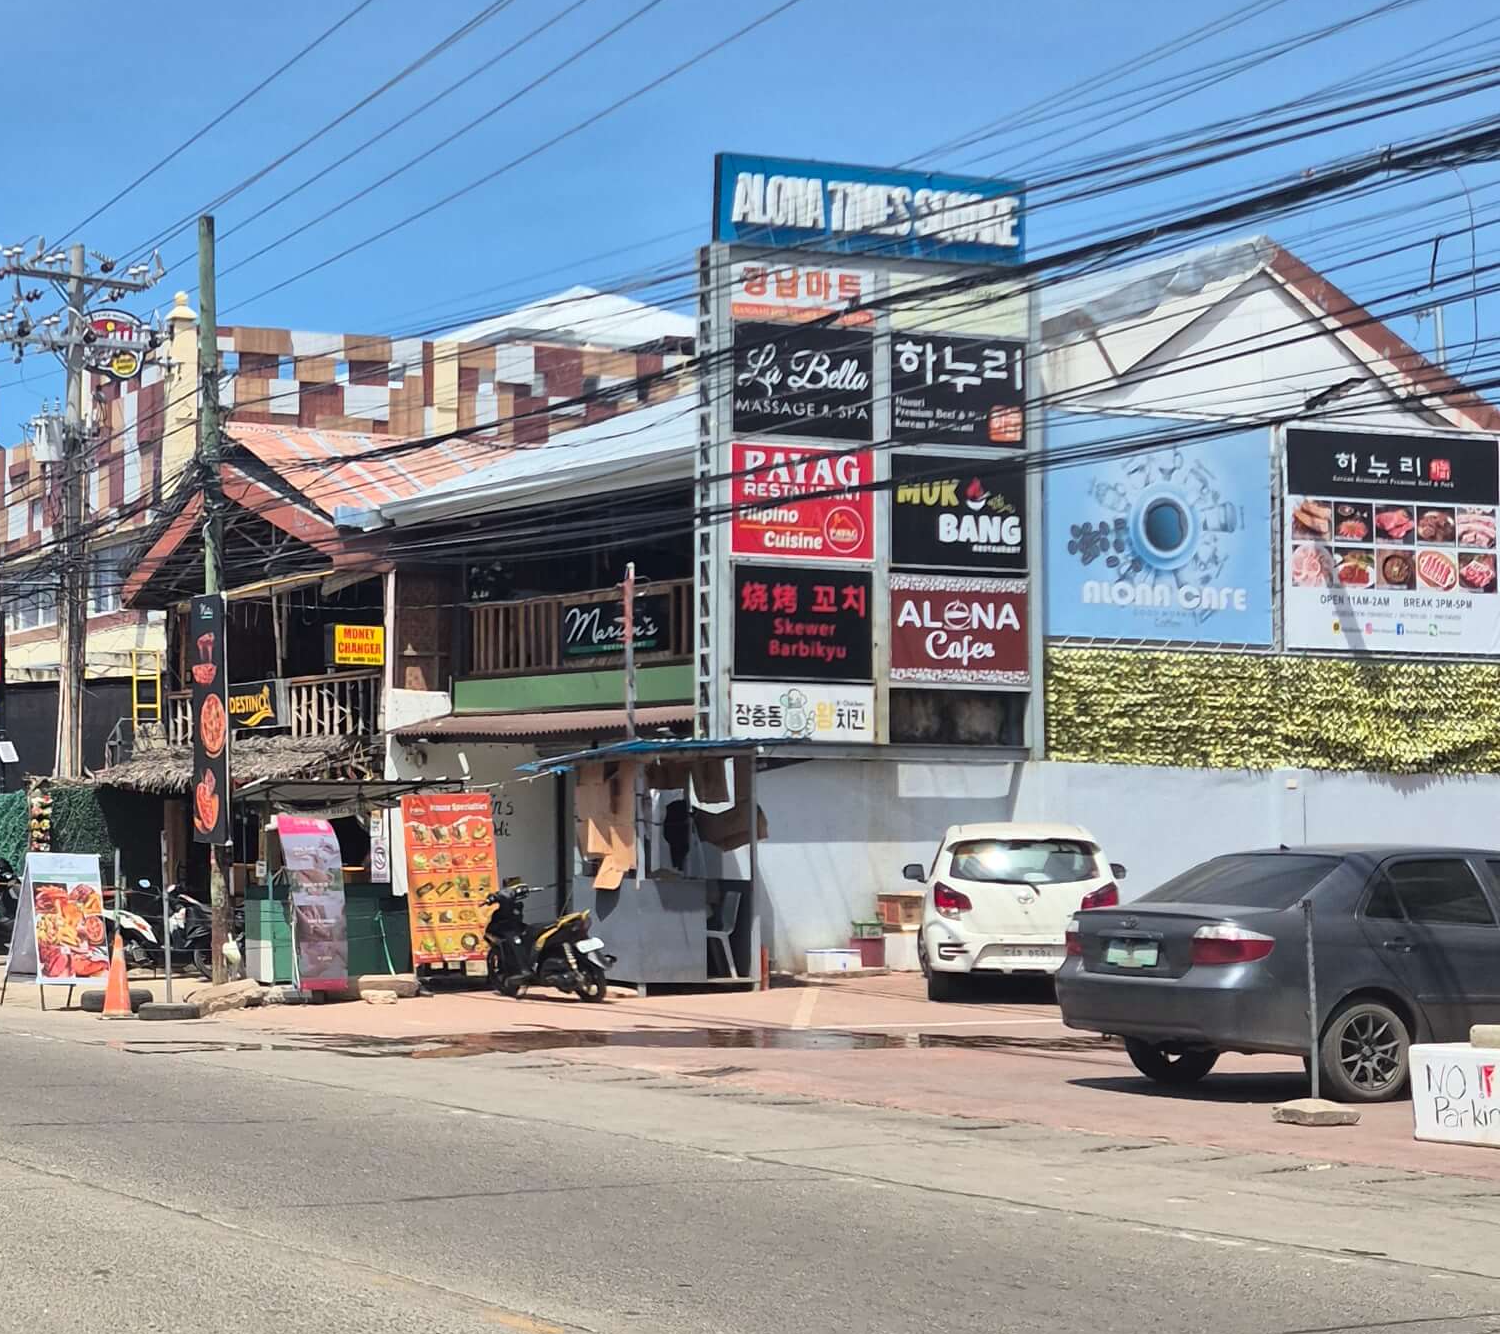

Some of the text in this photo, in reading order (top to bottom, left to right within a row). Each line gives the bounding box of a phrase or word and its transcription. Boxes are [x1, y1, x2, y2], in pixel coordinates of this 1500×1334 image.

[731, 172, 1020, 246] ALONA TIMES SQUARE
[737, 343, 869, 397] La Bella
[894, 340, 1024, 393] 하누리
[735, 398, 816, 418] MASSAGE
[838, 406, 869, 420] SPA
[743, 450, 860, 487] PAYAG
[1335, 452, 1421, 477] 하누리
[896, 478, 960, 507] MUK
[764, 530, 823, 550] Cuisine
[938, 513, 1022, 545] BANG
[741, 581, 798, 614] 烧烤
[1080, 579, 1248, 610] ALONA CAFE
[1320, 594, 1345, 605] OPEN
[1403, 597, 1433, 609] BREAK
[343, 628, 375, 640] MONEY
[564, 607, 658, 644] Martn's
[773, 618, 836, 637] Skewer
[338, 642, 381, 655] CHANGER
[768, 640, 847, 663] Barbikyu
[735, 704, 782, 728] 장충동
[1425, 1062, 1467, 1100] NO
